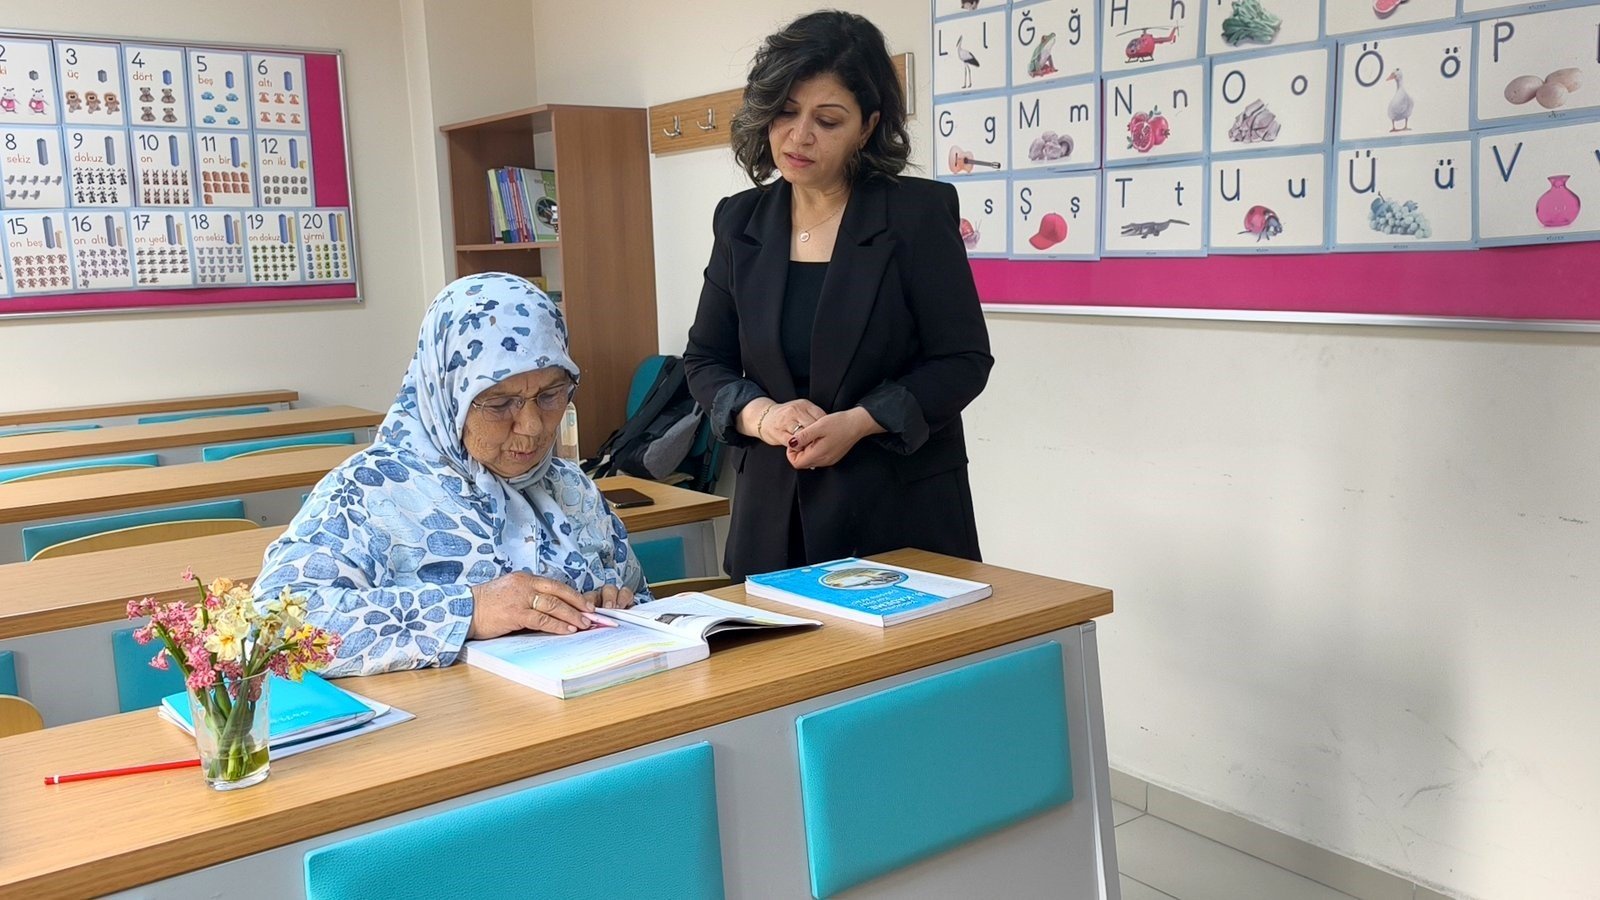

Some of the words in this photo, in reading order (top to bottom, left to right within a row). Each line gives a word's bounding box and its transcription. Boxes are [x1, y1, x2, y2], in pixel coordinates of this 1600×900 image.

[1110, 0, 1129, 28] H
[1017, 9, 1036, 47] Ğ
[1068, 7, 1081, 46] ğ
[938, 29, 949, 57] L
[982, 21, 989, 50] l
[1493, 21, 1515, 63] P
[65, 47, 78, 66] 3
[131, 51, 146, 69] 4
[196, 55, 208, 73] 5
[1354, 41, 1384, 88] Ö
[1440, 46, 1461, 79] ö
[257, 59, 269, 76] 6
[1222, 70, 1246, 105] O
[1290, 74, 1309, 96] o
[1114, 83, 1133, 117] N
[1172, 89, 1189, 109] n
[1019, 98, 1040, 130] M
[1069, 103, 1089, 123] m
[938, 110, 954, 138] G
[984, 116, 996, 145] g
[5, 133, 17, 151] 8
[73, 132, 83, 150] 9
[138, 134, 160, 151] 10
[201, 135, 217, 153] 11
[260, 137, 279, 155] 12
[262, 158, 274, 166] on
[1492, 141, 1523, 183] V
[1349, 149, 1376, 195] Ü
[1434, 158, 1455, 190] ü
[1114, 177, 1133, 209] T
[1174, 181, 1185, 207] t
[1220, 168, 1241, 202] U
[1287, 177, 1306, 199] u
[984, 198, 994, 215] s
[1020, 187, 1032, 221] Ş
[1070, 196, 1081, 219] ş
[7, 217, 28, 235] 15
[71, 215, 92, 233] 16
[132, 214, 151, 231] 17
[191, 213, 210, 230] 18
[247, 213, 264, 230] 19
[302, 213, 323, 230] 20
[73, 238, 87, 246] on
[134, 236, 146, 244] on
